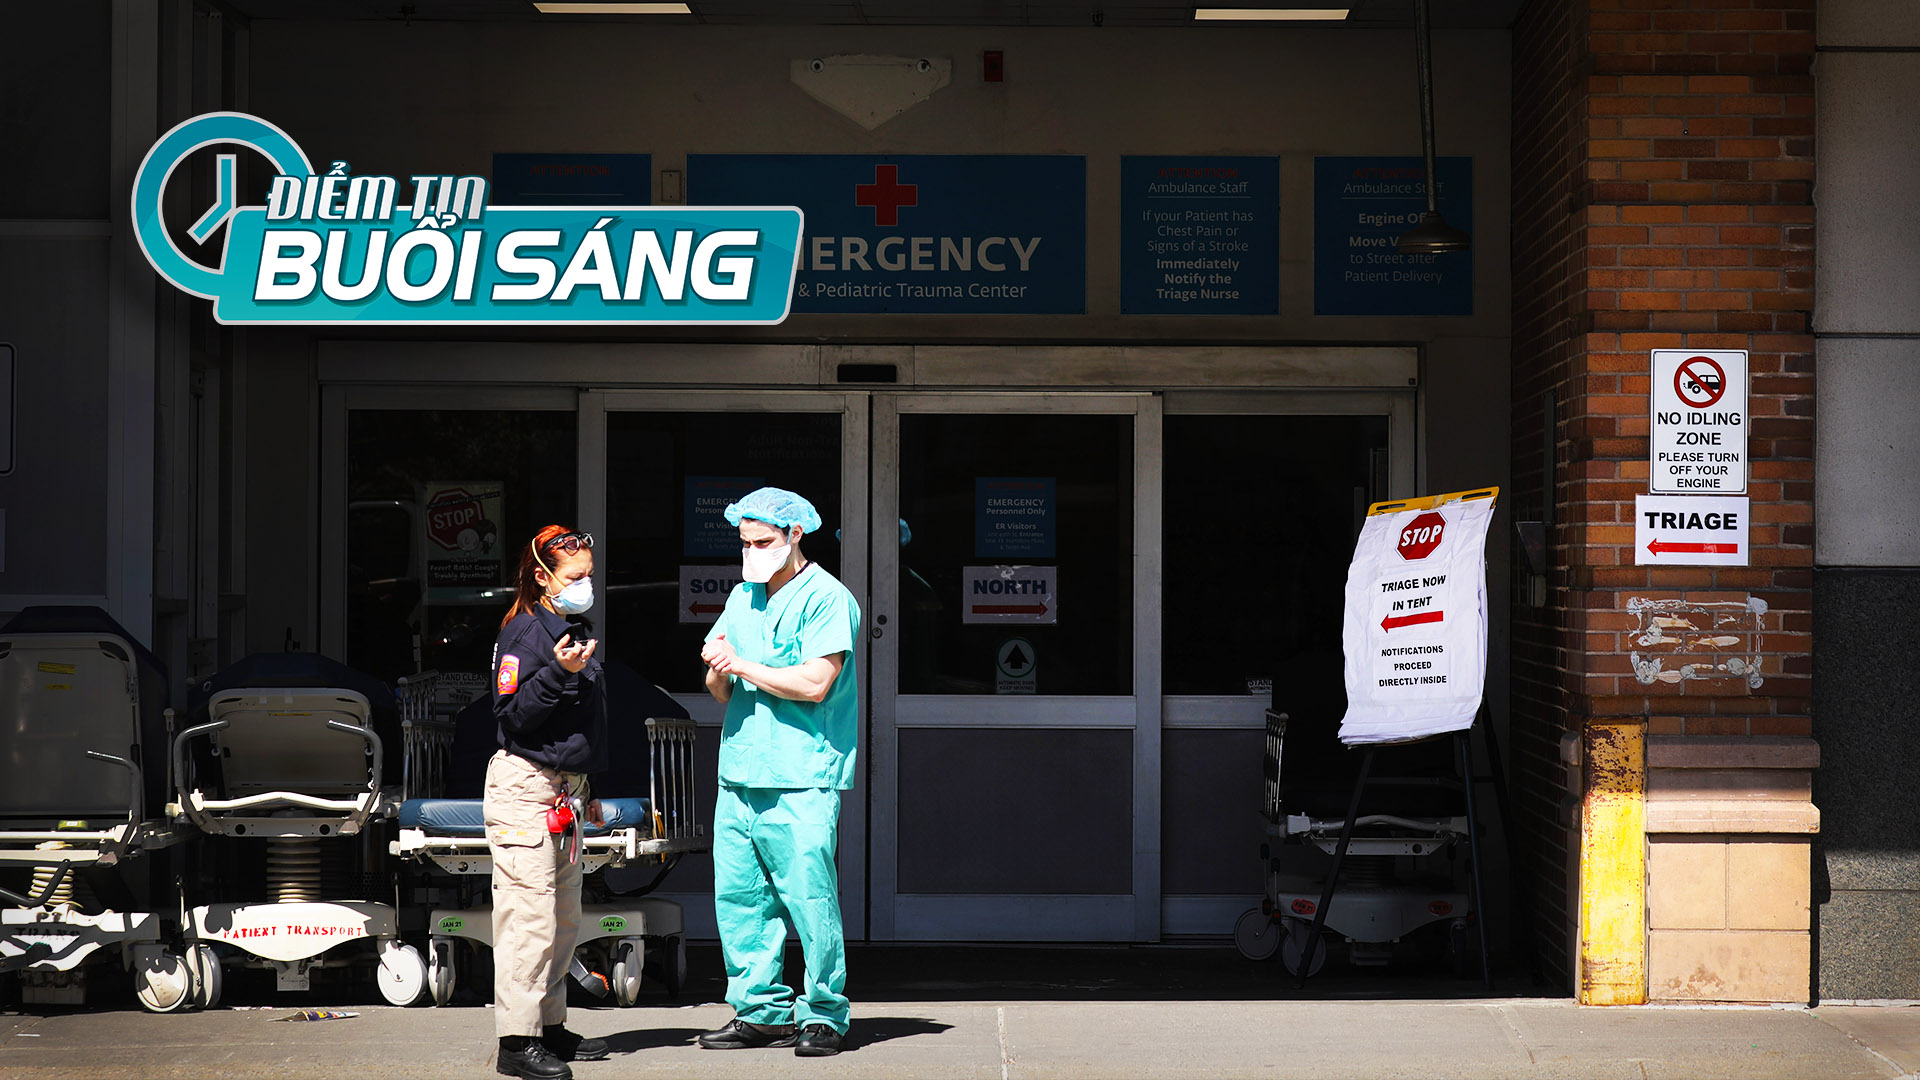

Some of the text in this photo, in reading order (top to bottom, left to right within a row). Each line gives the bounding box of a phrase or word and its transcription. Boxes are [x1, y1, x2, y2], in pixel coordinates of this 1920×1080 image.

[529, 163, 610, 177] ATTENTION
[1157, 167, 1238, 179] ATTENTION
[1353, 168, 1425, 179] ATTENTIO
[1148, 181, 1249, 194] Ambulance Staff
[1343, 183, 1412, 194] Ambulance
[1142, 210, 1254, 223] If your Patient has
[1358, 212, 1404, 227] Engine
[1157, 225, 1240, 237] Chest Pain or
[1147, 240, 1249, 254] Signs of a Stroke
[1349, 236, 1386, 248] Move
[798, 236, 1042, 272] ERGENCY
[1350, 253, 1437, 265] to Street after
[1156, 258, 1240, 272] Immediately
[1164, 273, 1232, 287] Notify the
[1344, 270, 1443, 285] Patient Delivery
[798, 282, 1027, 298] & Pediatric Trauma Center
[1156, 288, 1240, 302] Triage Nurse
[1657, 412, 1741, 426] NO IDLING
[1676, 432, 1722, 446] ZONE
[1658, 453, 1739, 463] PLEASE TURN
[1669, 466, 1728, 476] OFF YOUR
[1676, 479, 1721, 489] ENGINE
[987, 498, 1045, 507] EMERGENCY
[433, 507, 475, 530] STOP
[1026, 508, 1046, 516] Only
[995, 522, 1037, 530] ER Visitors
[1644, 511, 1738, 530] TRIAGE
[1401, 524, 1442, 548] STOP
[973, 580, 1047, 595] NORTH
[1381, 575, 1446, 593] TRIAGE NOW
[1392, 596, 1433, 611] IN TENT
[1381, 645, 1444, 657] NOTIFICATIONS
[1394, 661, 1432, 671] PROCEED
[437, 673, 488, 681] STAND CLEAR
[1379, 675, 1447, 687] DIRECTLY INSIDE
[223, 925, 362, 939] PATIENT TRANSPORT
